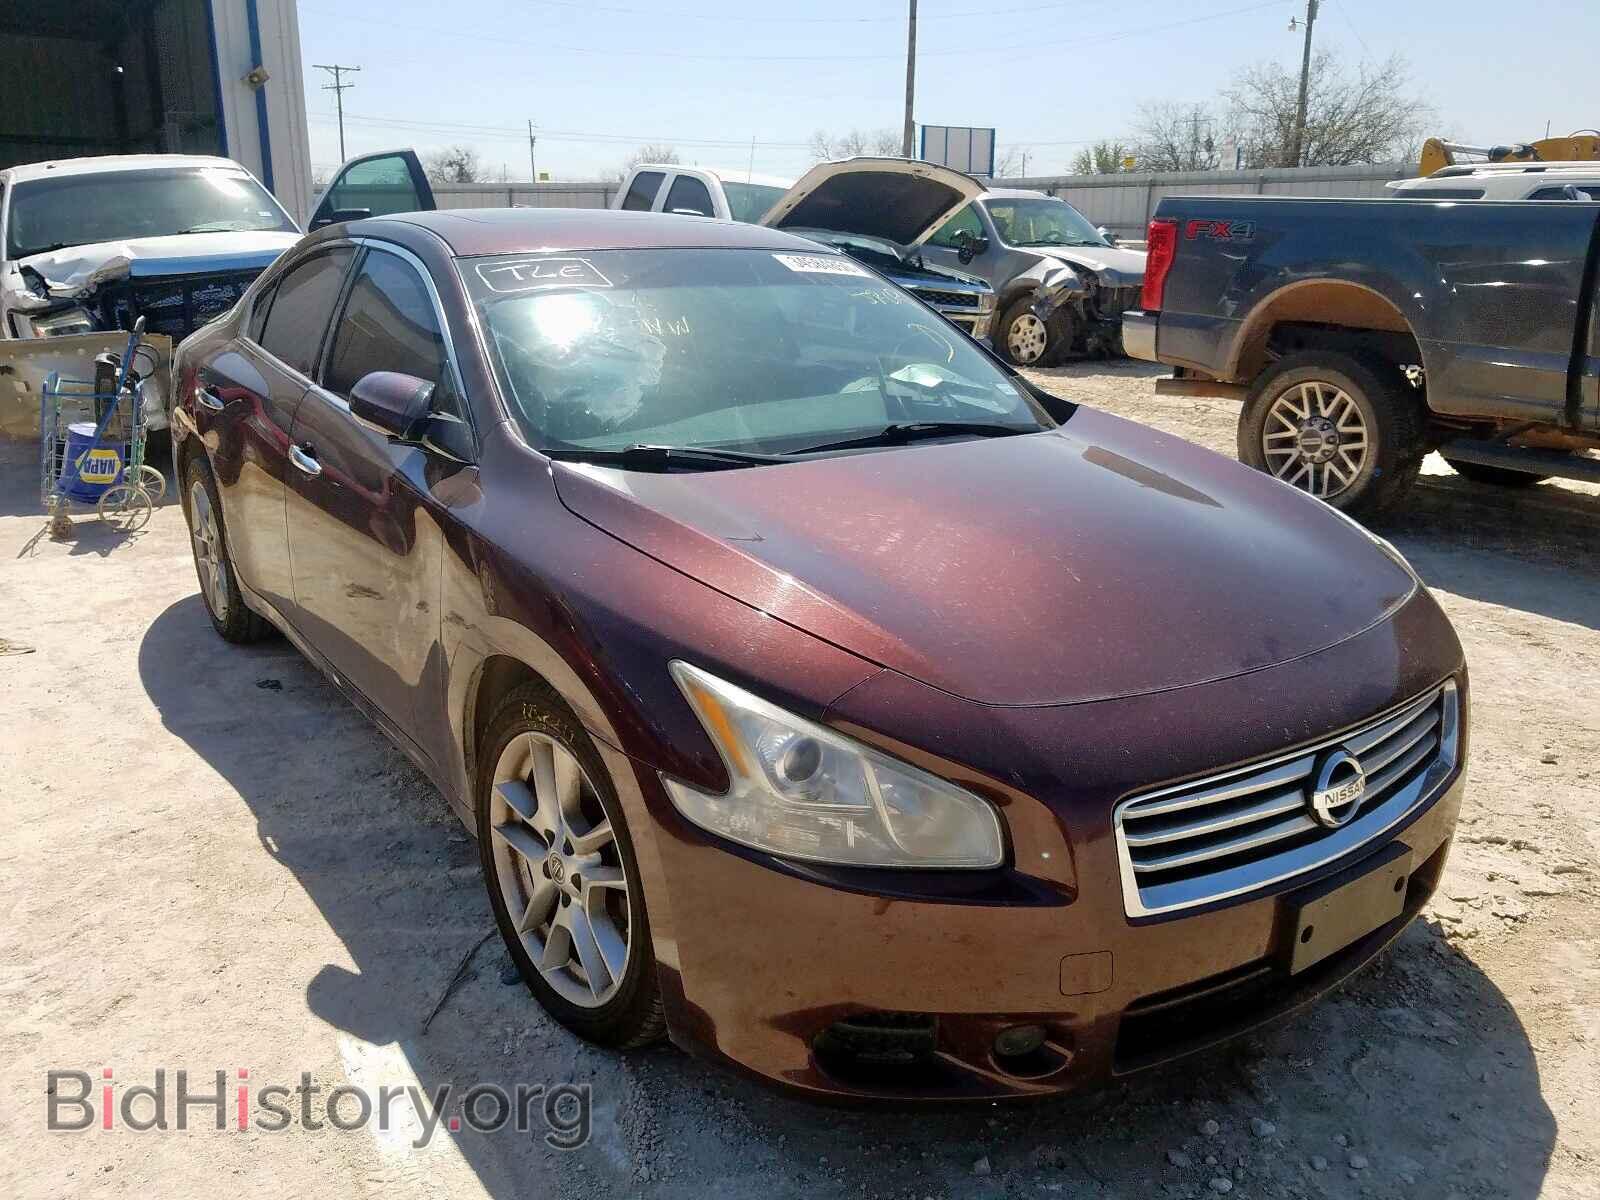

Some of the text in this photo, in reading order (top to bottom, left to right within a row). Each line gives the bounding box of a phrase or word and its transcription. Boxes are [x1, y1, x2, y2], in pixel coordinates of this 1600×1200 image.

[1184, 219, 1255, 239] FX4
[488, 264, 585, 281] TLE
[83, 458, 116, 474] NAPA
[1325, 781, 1365, 805] NISSAN
